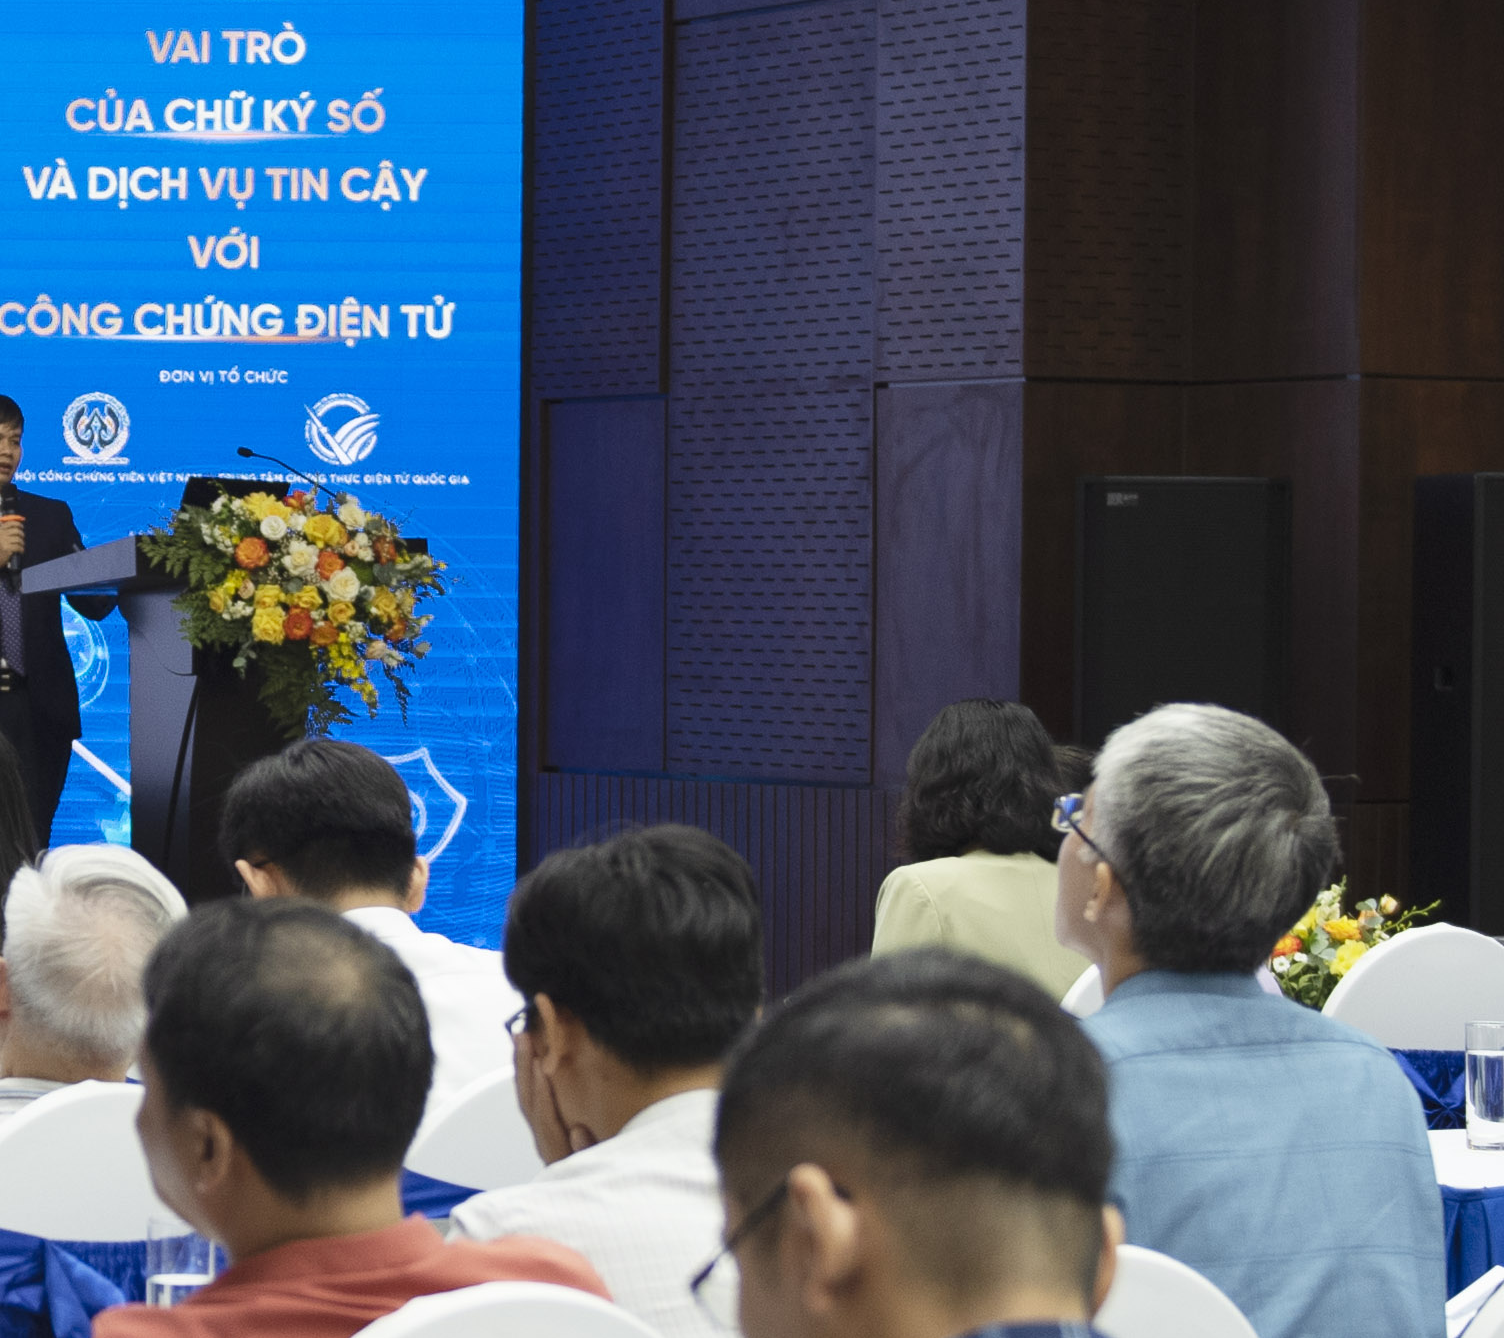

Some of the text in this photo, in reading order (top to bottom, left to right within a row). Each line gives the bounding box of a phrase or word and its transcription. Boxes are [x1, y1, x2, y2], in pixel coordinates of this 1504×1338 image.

[146, 22, 306, 64] VAI TRÒ
[66, 88, 385, 135] CỦA CHỮ KÝ SỐ
[23, 158, 427, 210] VÀ DỊCH VỤ TIN CẬY
[188, 227, 259, 269] VỚI
[132, 295, 286, 340] CHỨNG
[294, 297, 389, 347] ĐIỆN
[400, 295, 455, 339] TỬ
